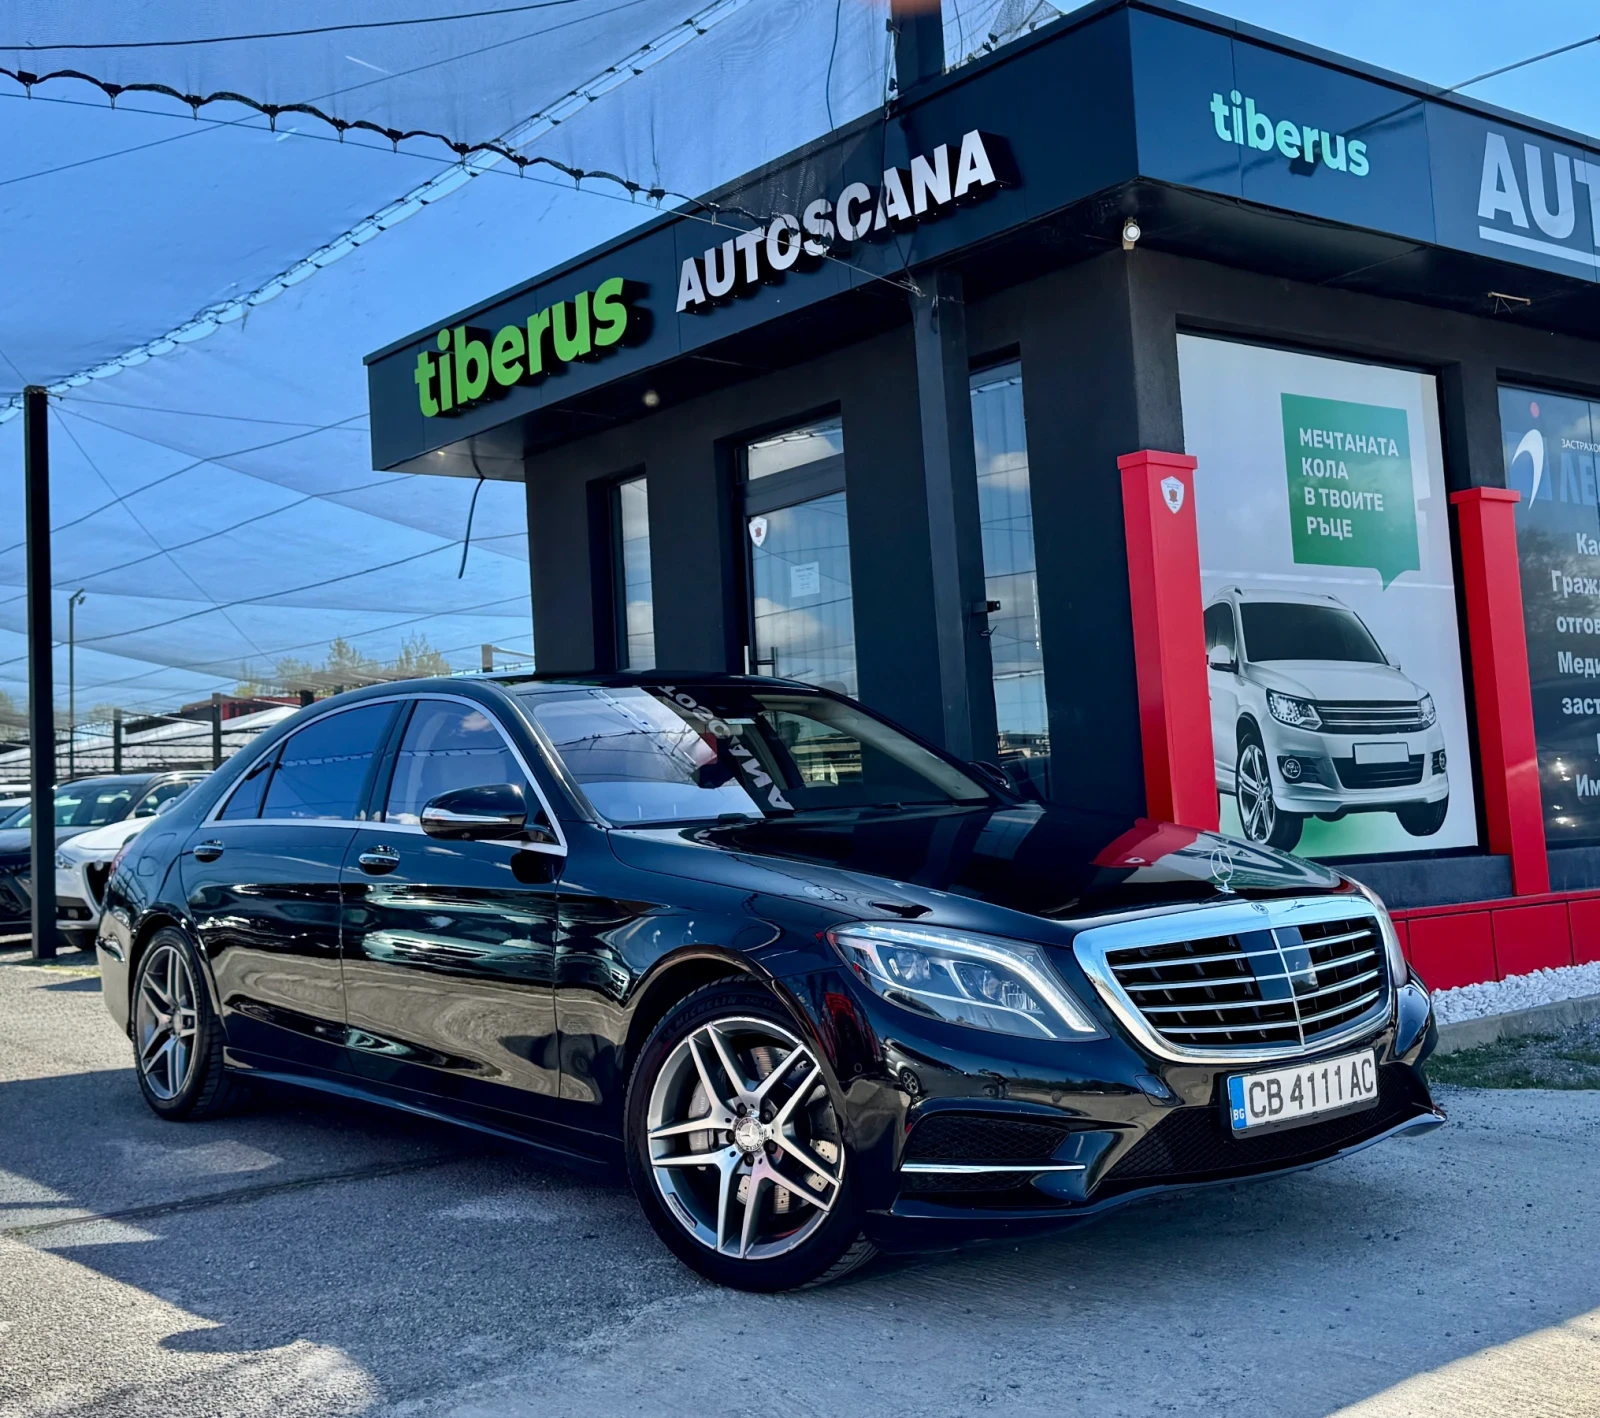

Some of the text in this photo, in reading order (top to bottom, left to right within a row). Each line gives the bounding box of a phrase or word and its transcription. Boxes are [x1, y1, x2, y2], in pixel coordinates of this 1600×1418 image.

[1210, 90, 1370, 177] tiberus
[414, 129, 996, 418] tiberus AUTOSCANA
[1299, 428, 1399, 457] МЕЧТАНАТА
[1561, 438, 1600, 453] ЗАСТРАХО
[1302, 457, 1349, 480] КОЛА
[1304, 486, 1384, 511] В ТВОИТЕ
[1307, 516, 1353, 540] РЪЦЕ
[1576, 533, 1600, 556] Ка
[1551, 570, 1600, 598] Граж
[1249, 1058, 1374, 1118] CB 4111 AC
[1233, 1108, 1245, 1120] BG
